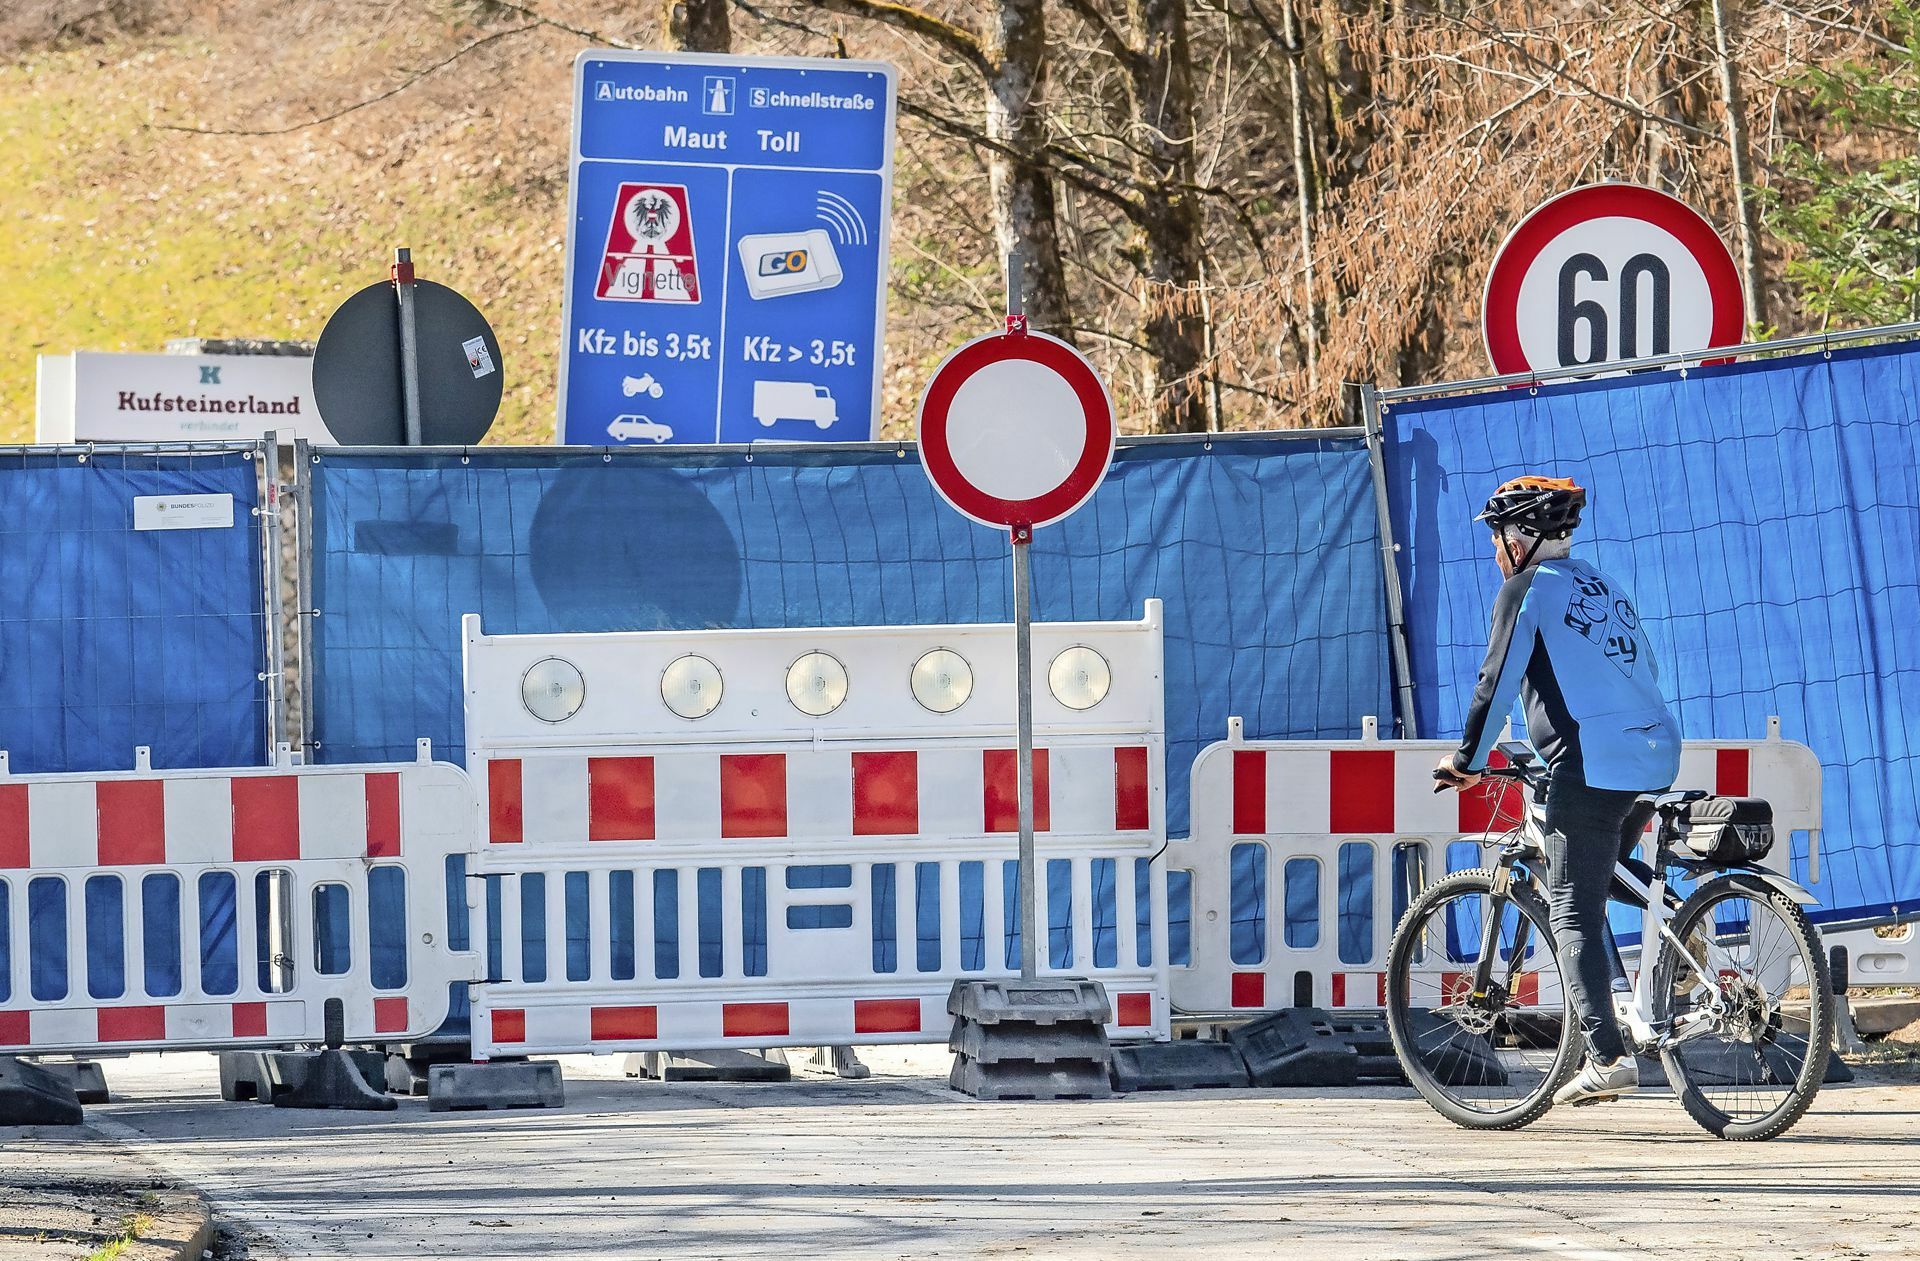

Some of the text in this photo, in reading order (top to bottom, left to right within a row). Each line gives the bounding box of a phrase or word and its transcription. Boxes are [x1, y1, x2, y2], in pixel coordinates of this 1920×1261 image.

[597, 83, 875, 110] Autobahn Schnellstraße
[663, 126, 800, 152] Maut Toll
[771, 250, 807, 271] GO
[604, 262, 695, 294] Vignette
[1557, 252, 1670, 379] 60
[578, 328, 711, 361] Kfz bis 3,5t
[743, 336, 781, 363] Kfz
[810, 339, 856, 368] 3,5t
[199, 366, 221, 384] K
[118, 391, 301, 414] Kufsteinerland
[1536, 491, 1554, 503] uvex
